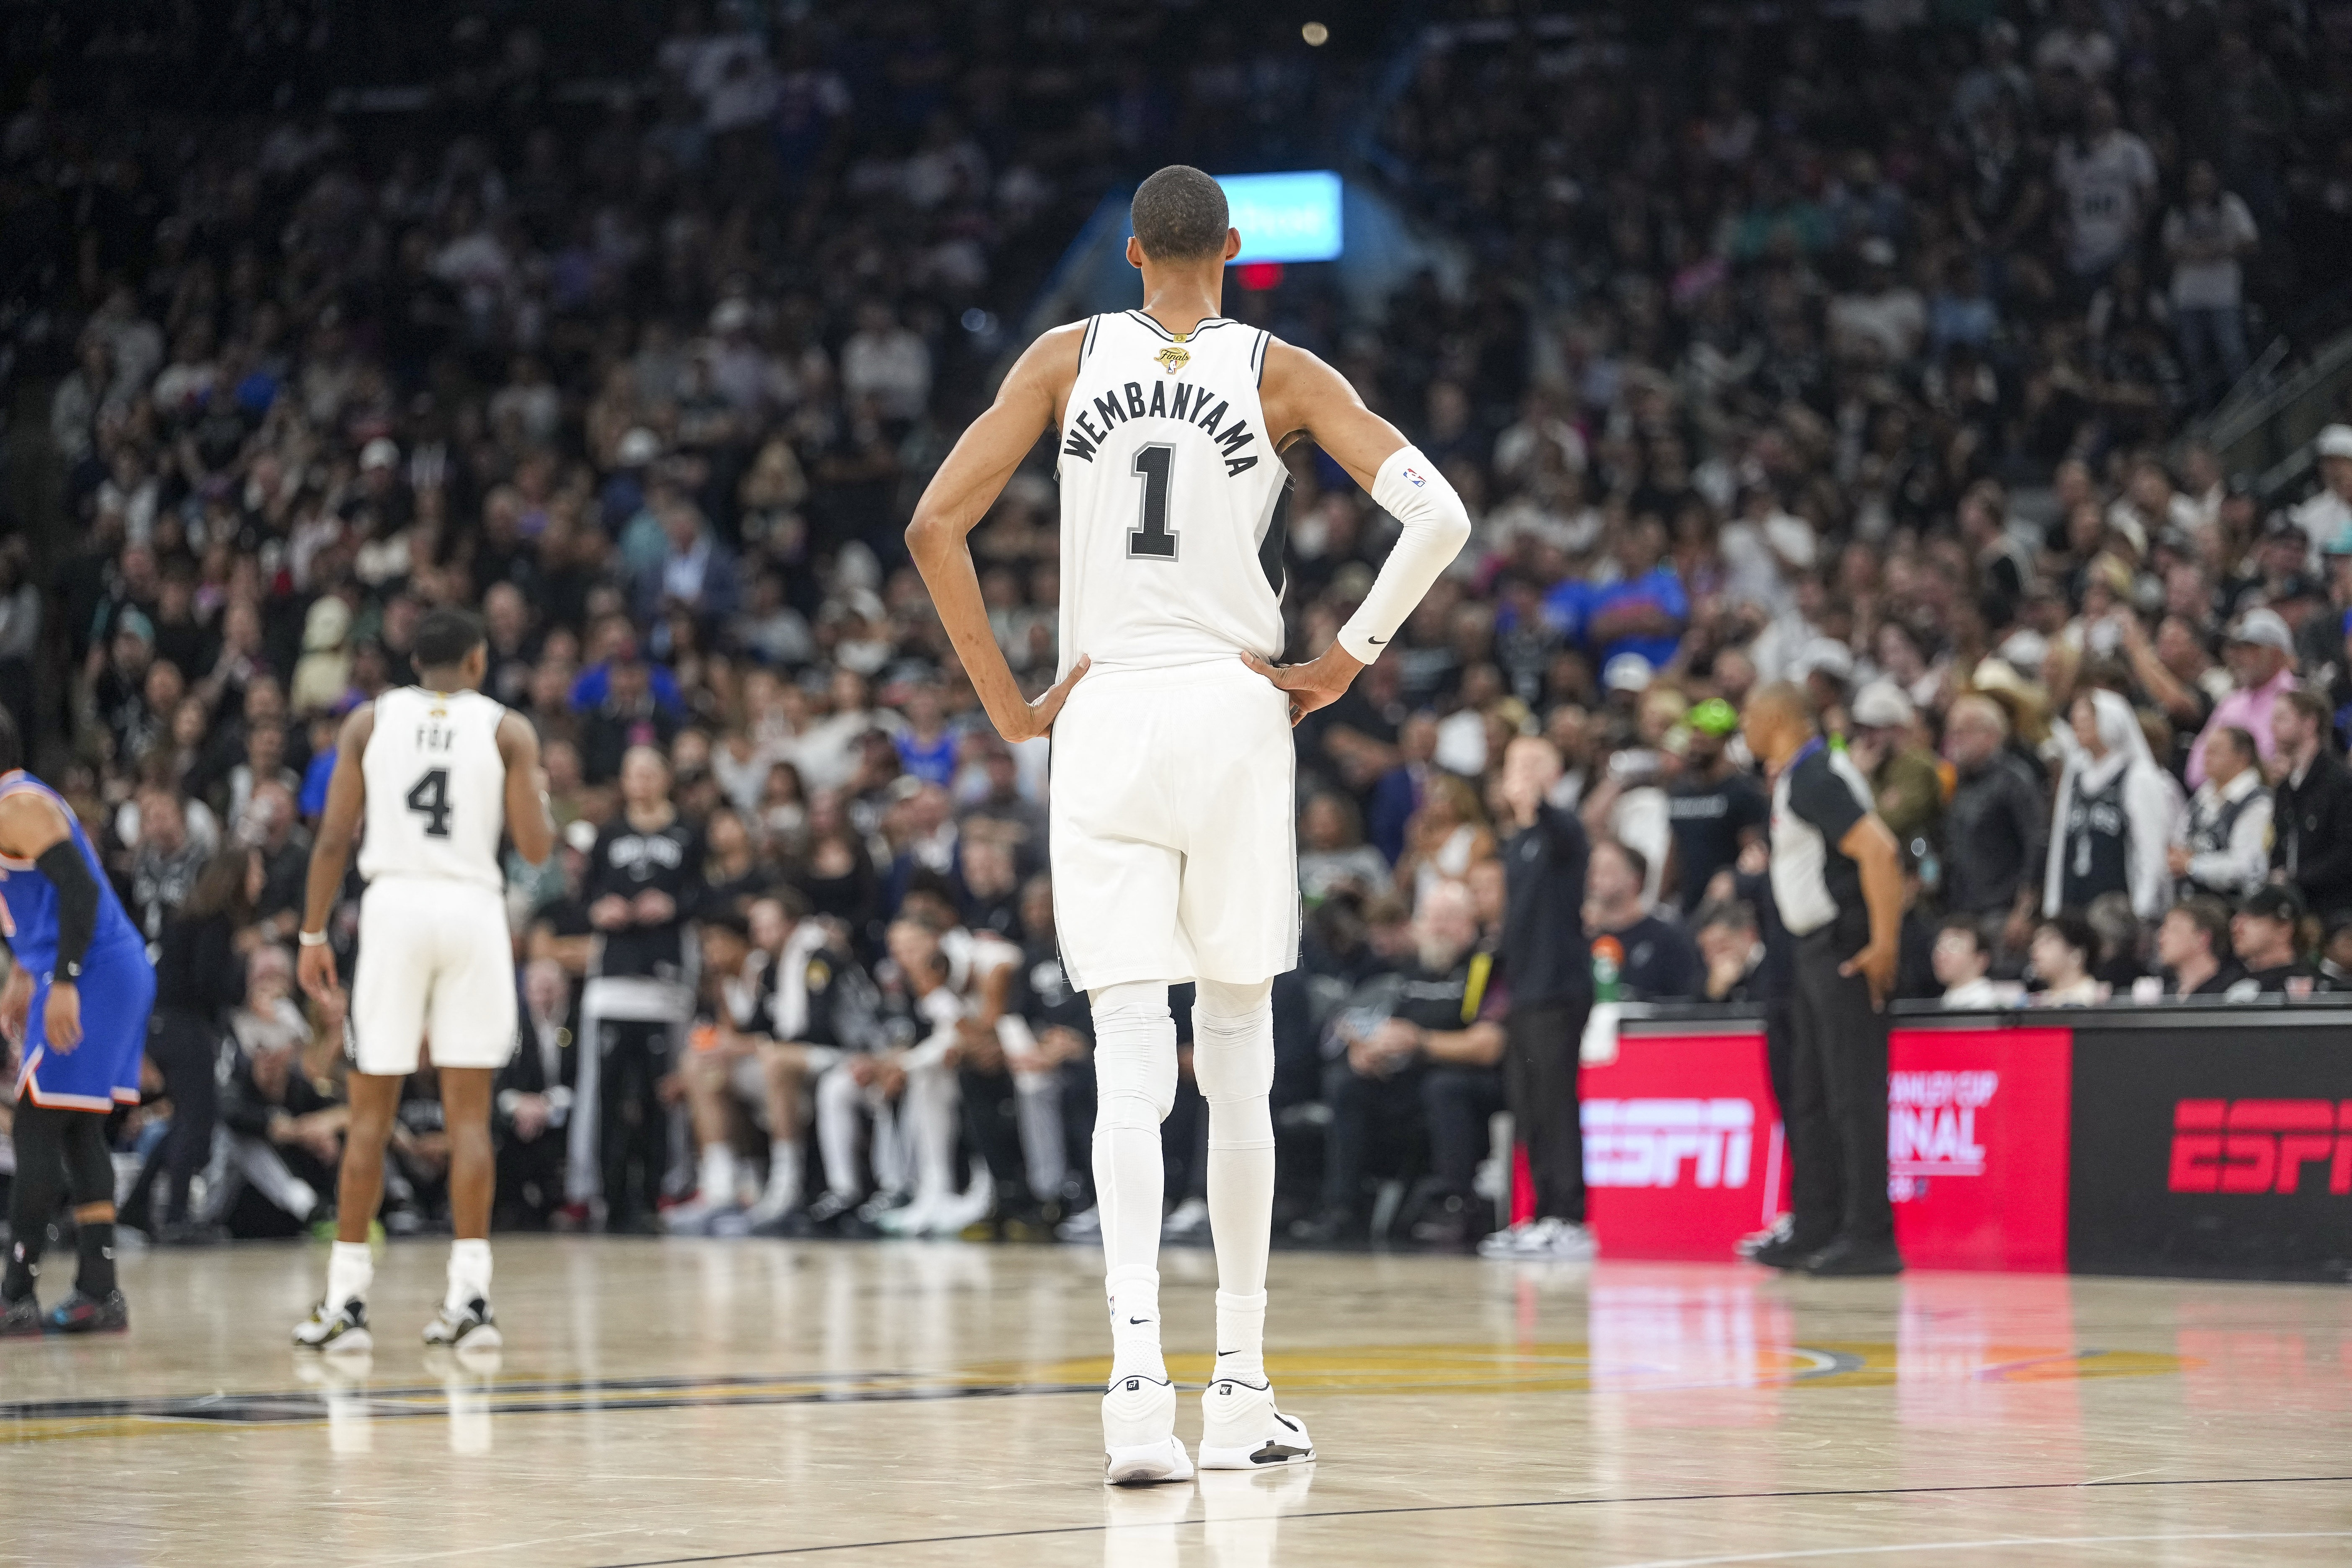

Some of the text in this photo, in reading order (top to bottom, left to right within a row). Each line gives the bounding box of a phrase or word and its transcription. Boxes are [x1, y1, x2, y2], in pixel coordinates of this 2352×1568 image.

[1156, 349, 1189, 361] Finals
[1063, 380, 1258, 477] WEMBANYAMA
[1126, 441, 1179, 562] 1
[405, 767, 451, 838] 4
[1580, 1097, 1754, 1188] ESPN
[1888, 1107, 1986, 1163] INAL
